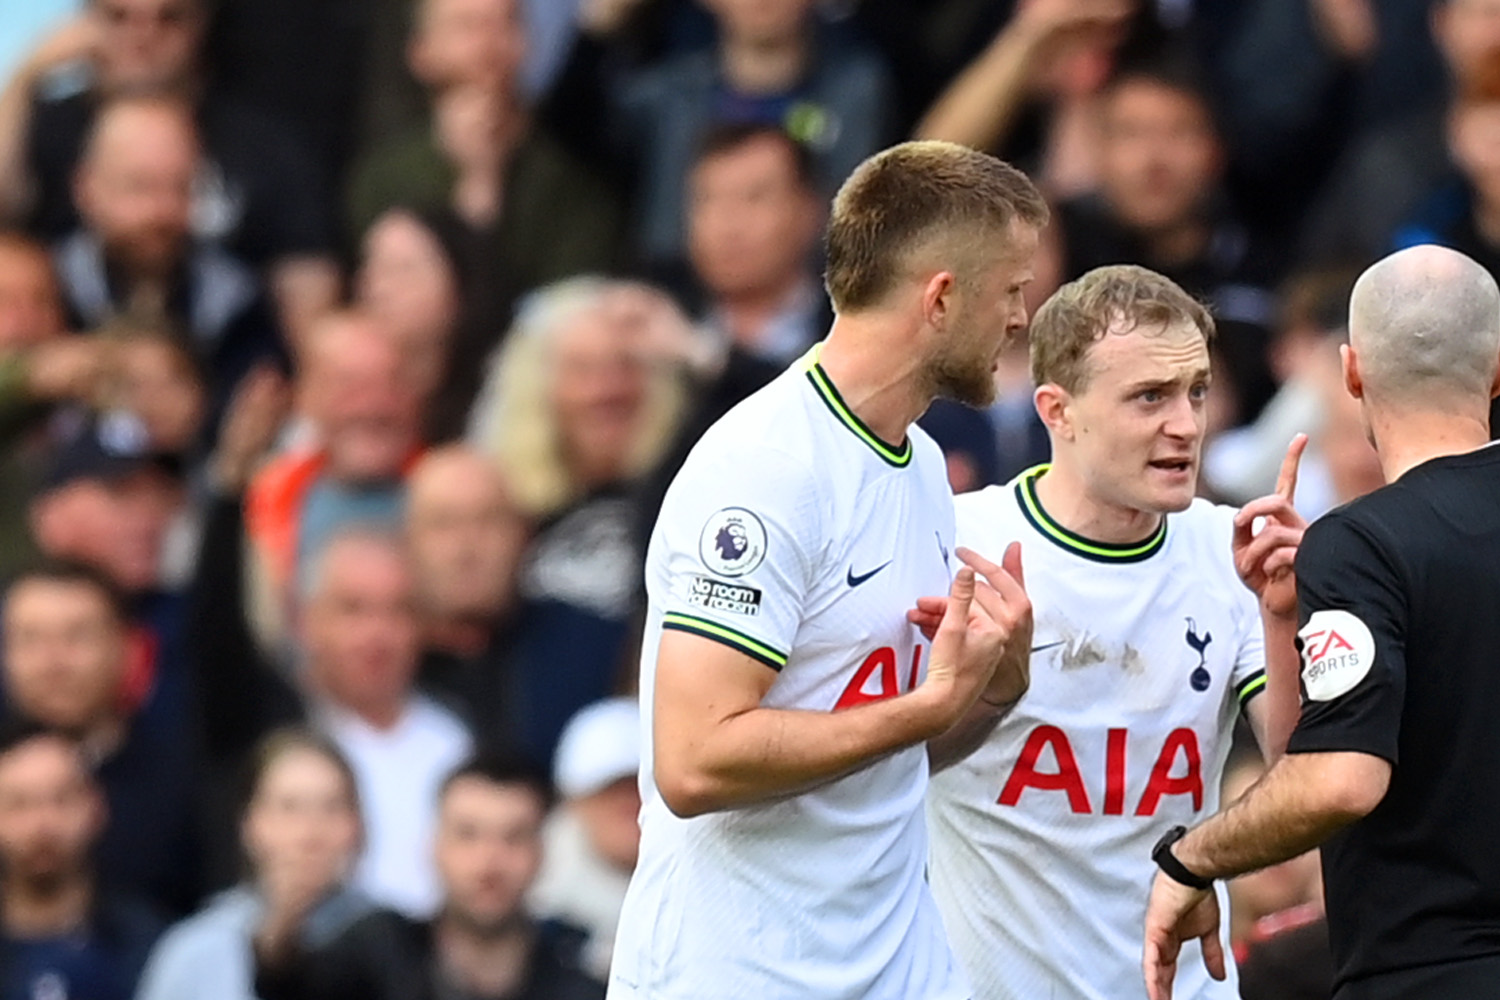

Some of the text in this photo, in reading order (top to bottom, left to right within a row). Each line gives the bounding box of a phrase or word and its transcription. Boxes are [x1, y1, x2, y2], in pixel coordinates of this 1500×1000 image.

[711, 583, 755, 604] room
[1305, 629, 1355, 664] EA
[996, 724, 1204, 816] AIA
